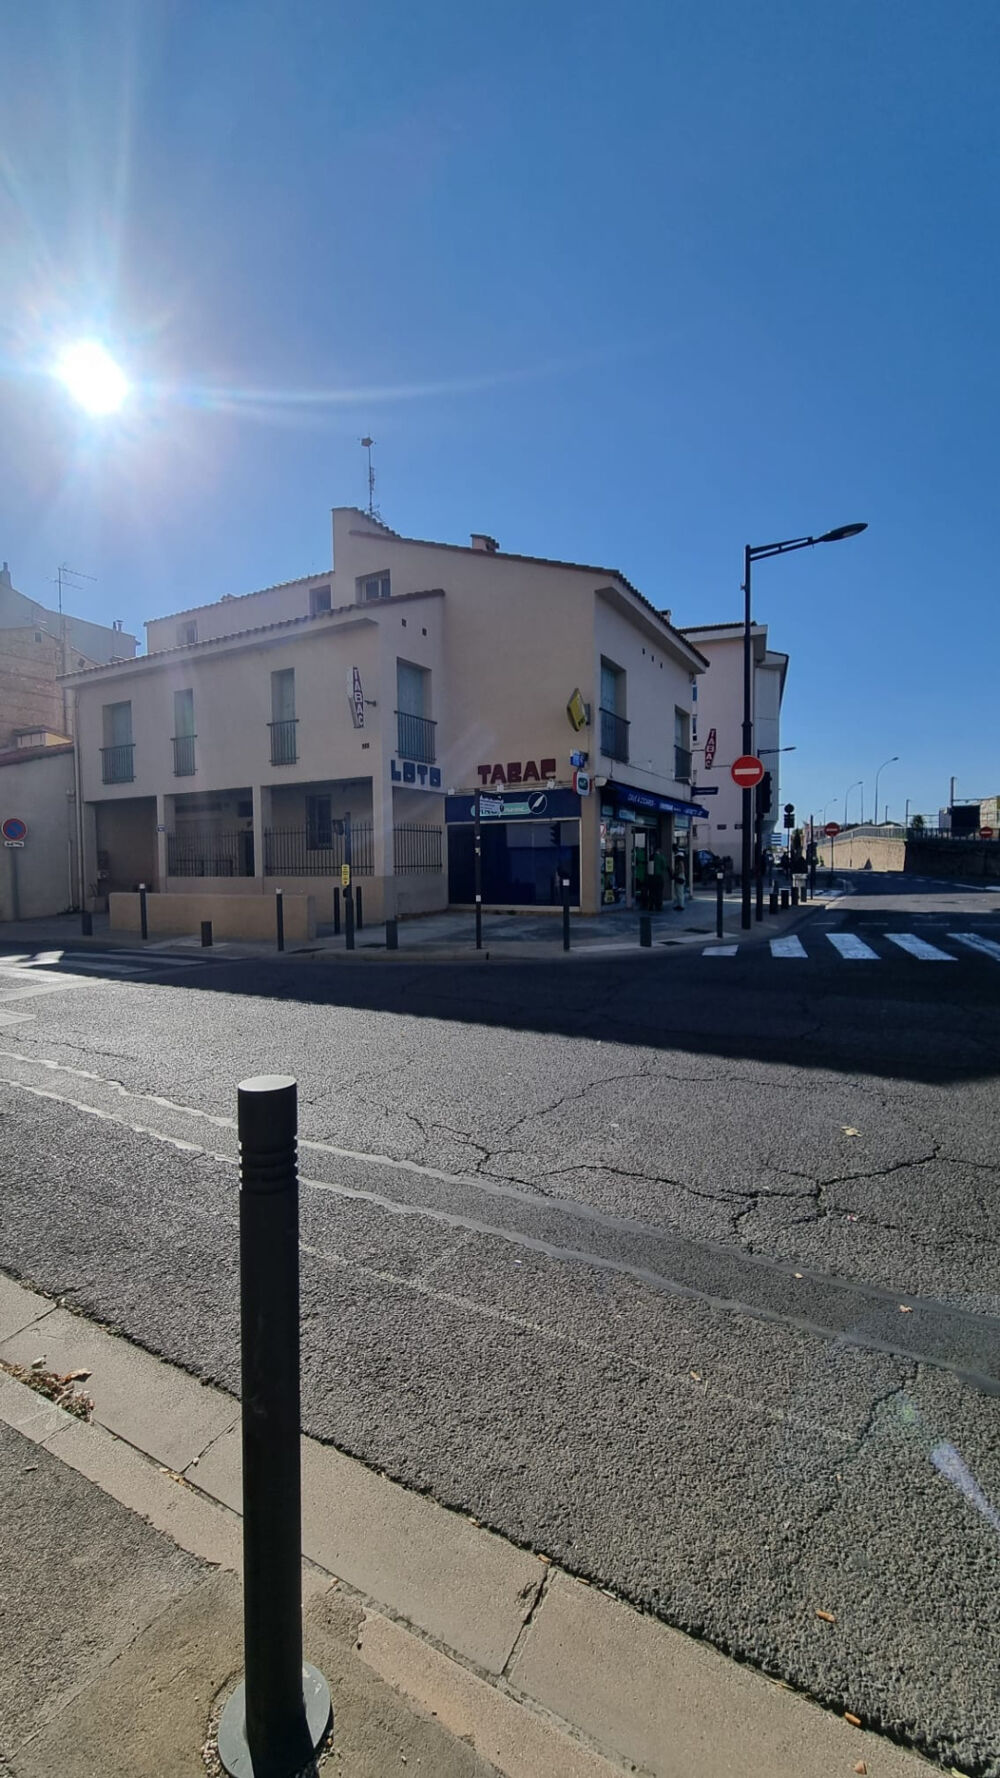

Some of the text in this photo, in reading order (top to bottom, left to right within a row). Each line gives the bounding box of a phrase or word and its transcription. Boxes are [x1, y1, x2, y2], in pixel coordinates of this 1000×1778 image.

[354, 669, 364, 725] TABAC
[705, 730, 715, 767] TABAC
[391, 760, 441, 787] LOTO
[478, 759, 556, 785] TABAC
